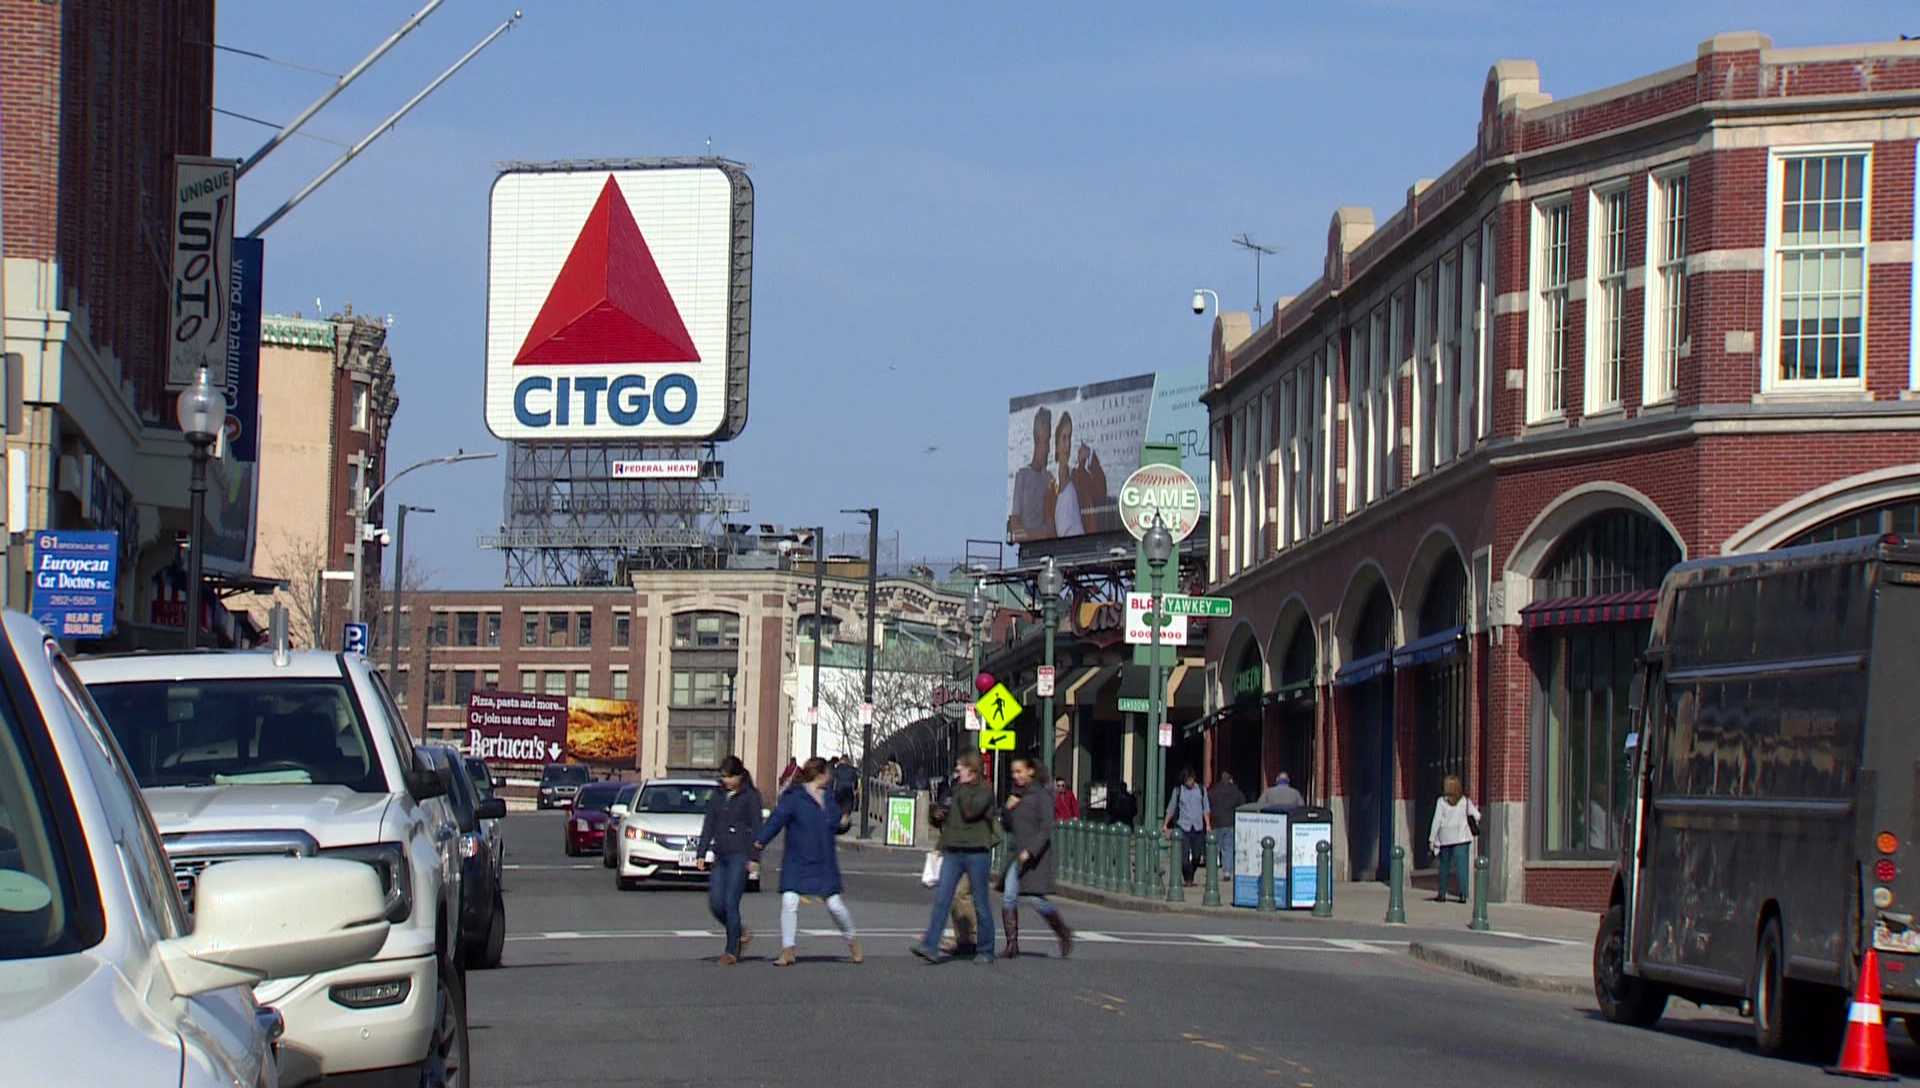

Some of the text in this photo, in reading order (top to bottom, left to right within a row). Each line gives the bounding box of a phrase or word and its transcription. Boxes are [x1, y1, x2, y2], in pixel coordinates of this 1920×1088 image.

[180, 170, 230, 203] UNIQUE
[513, 373, 698, 427] CITGO
[624, 464, 697, 473] FEDERAL HEATH
[1123, 487, 1196, 509] GAME
[40, 536, 58, 549] 61
[40, 554, 109, 574] European
[37, 572, 56, 588] Car
[58, 572, 95, 589] Doctors
[1167, 598, 1213, 613] YAWKEY
[65, 612, 103, 623] REAR OF
[64, 623, 104, 634] BUILDING
[472, 695, 566, 711] Pizza, pasta and more...
[471, 712, 555, 727] Or join us at our bar!
[470, 728, 545, 760] Bertucci's
